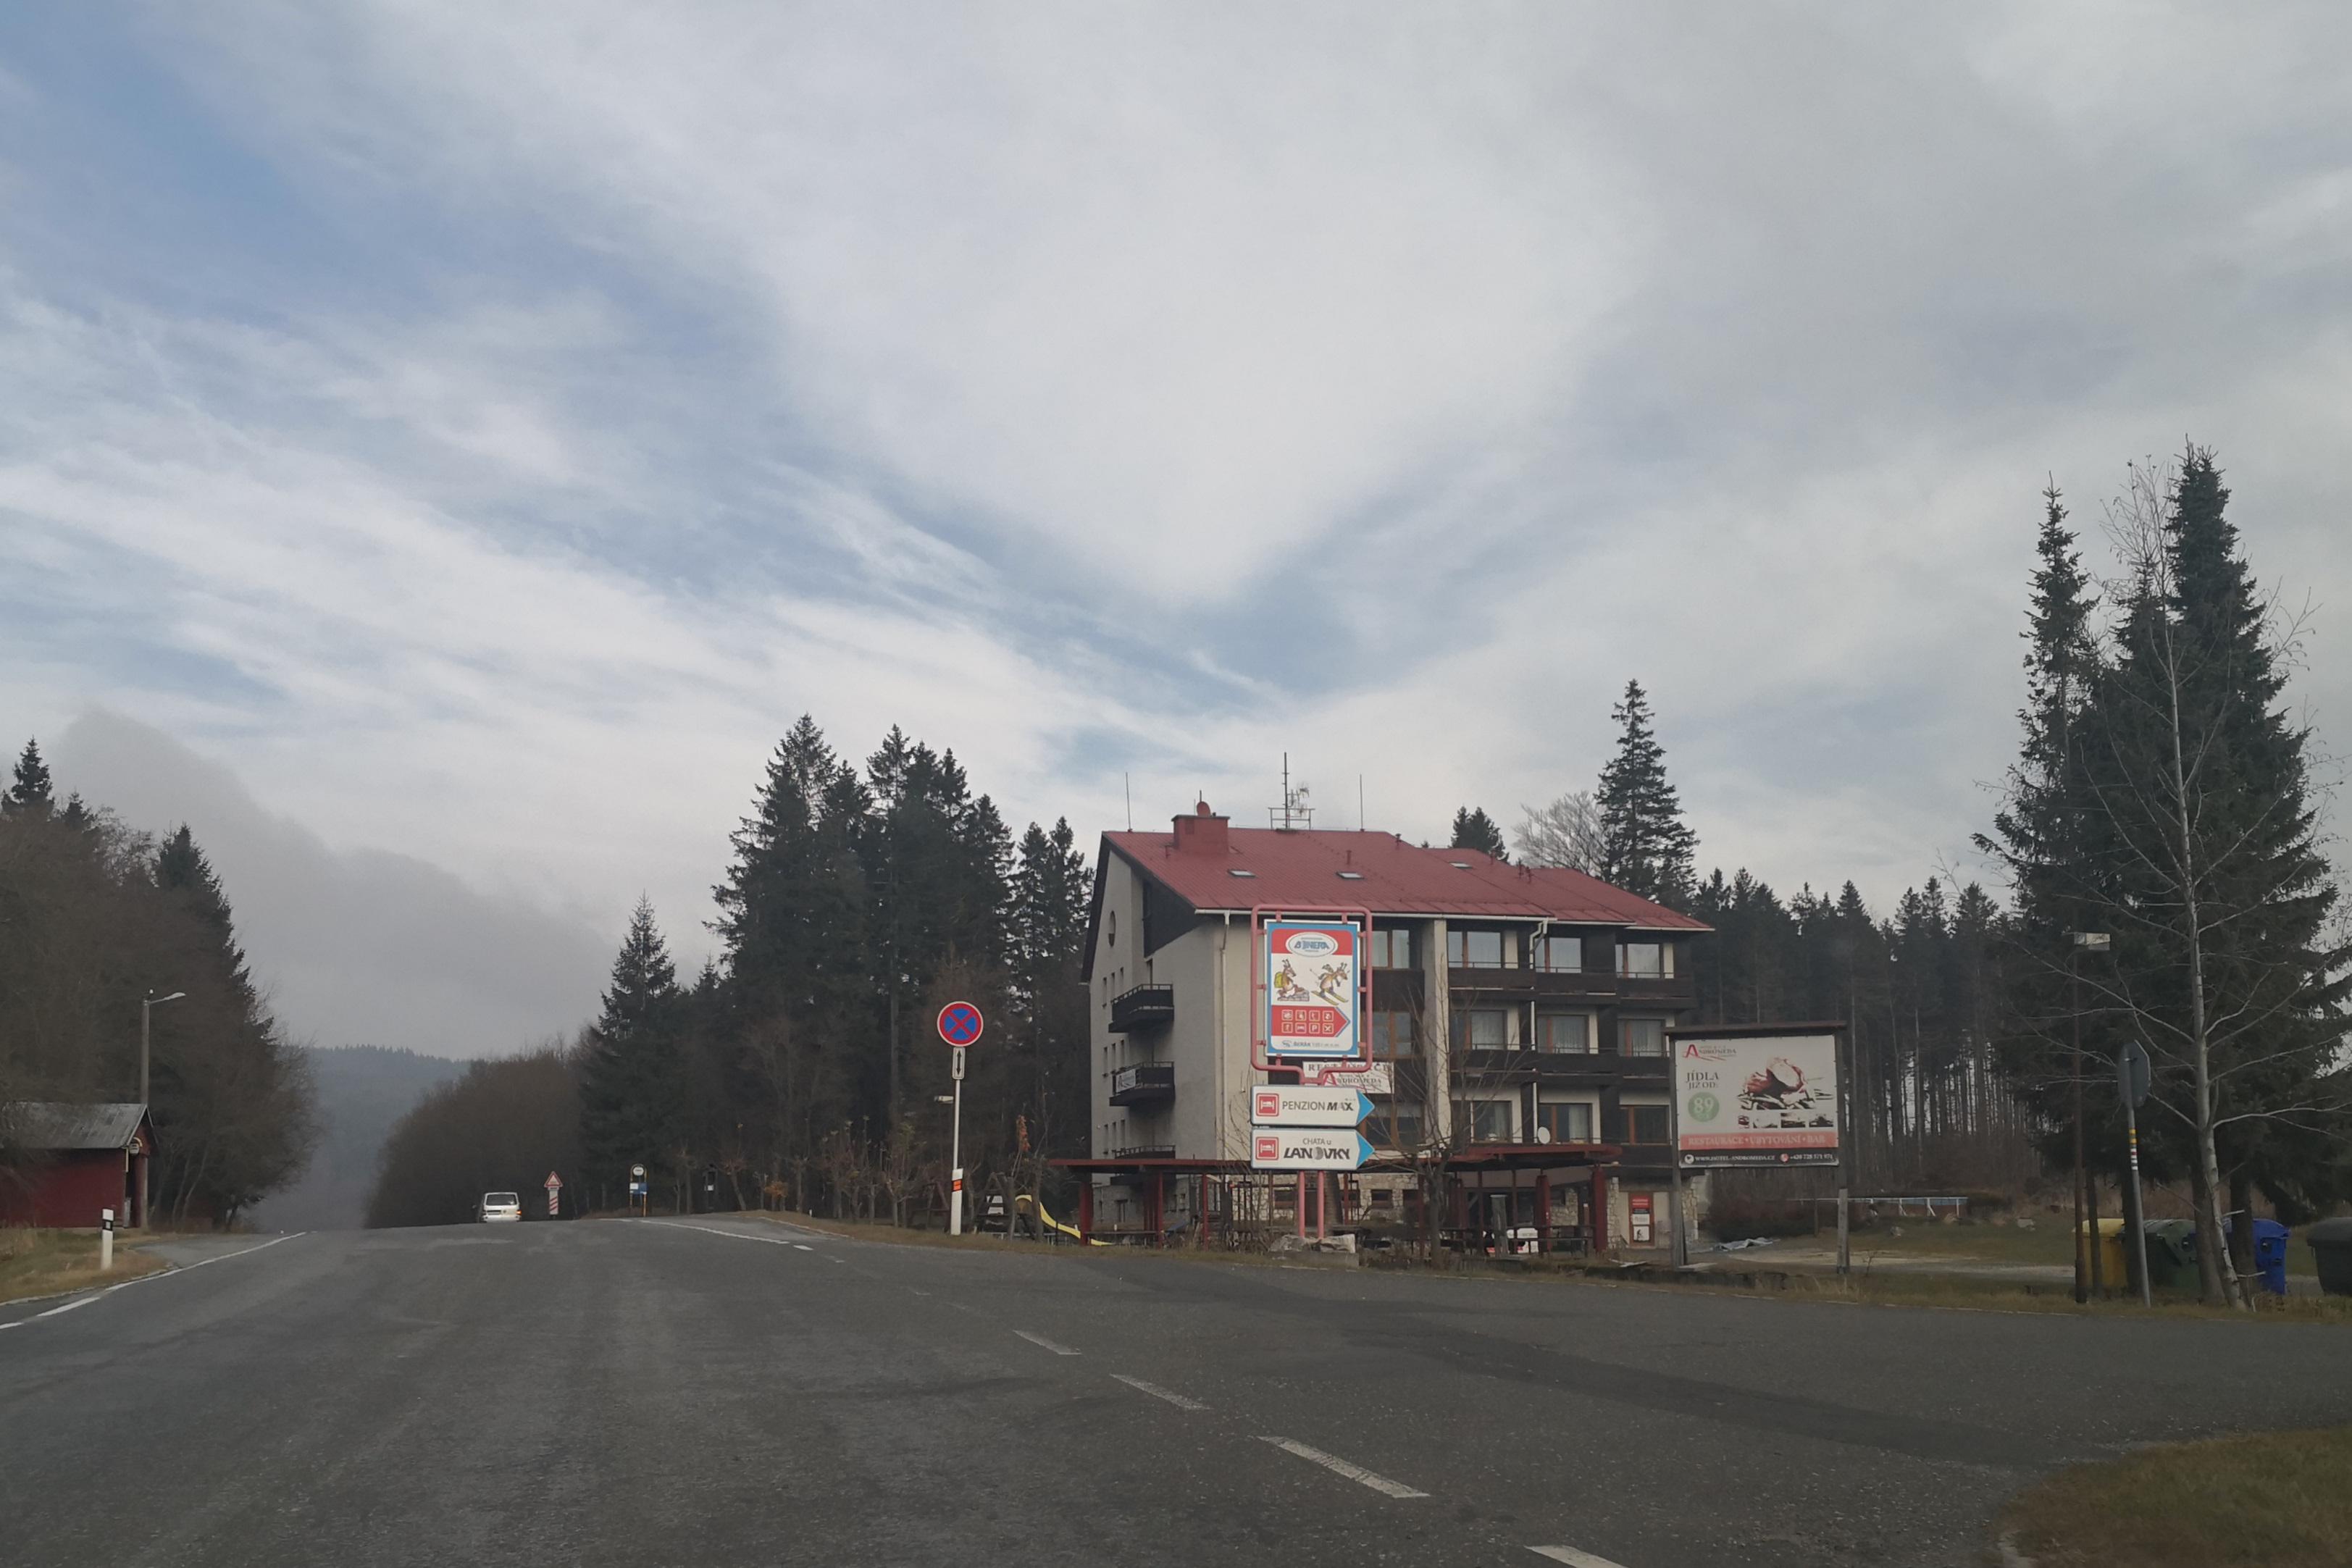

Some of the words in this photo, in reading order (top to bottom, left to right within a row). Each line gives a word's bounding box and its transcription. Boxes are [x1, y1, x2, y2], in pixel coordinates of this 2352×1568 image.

[1686, 1070, 1719, 1083] JÍDLA
[1282, 1100, 1326, 1110] PENZION
[1326, 1102, 1354, 1111] MAX
[1694, 1097, 1715, 1113] 89
[1688, 1136, 1744, 1146] RESTAURACE
[1807, 1135, 1826, 1144] BAR
[1284, 1146, 1350, 1160] LANOVKY
